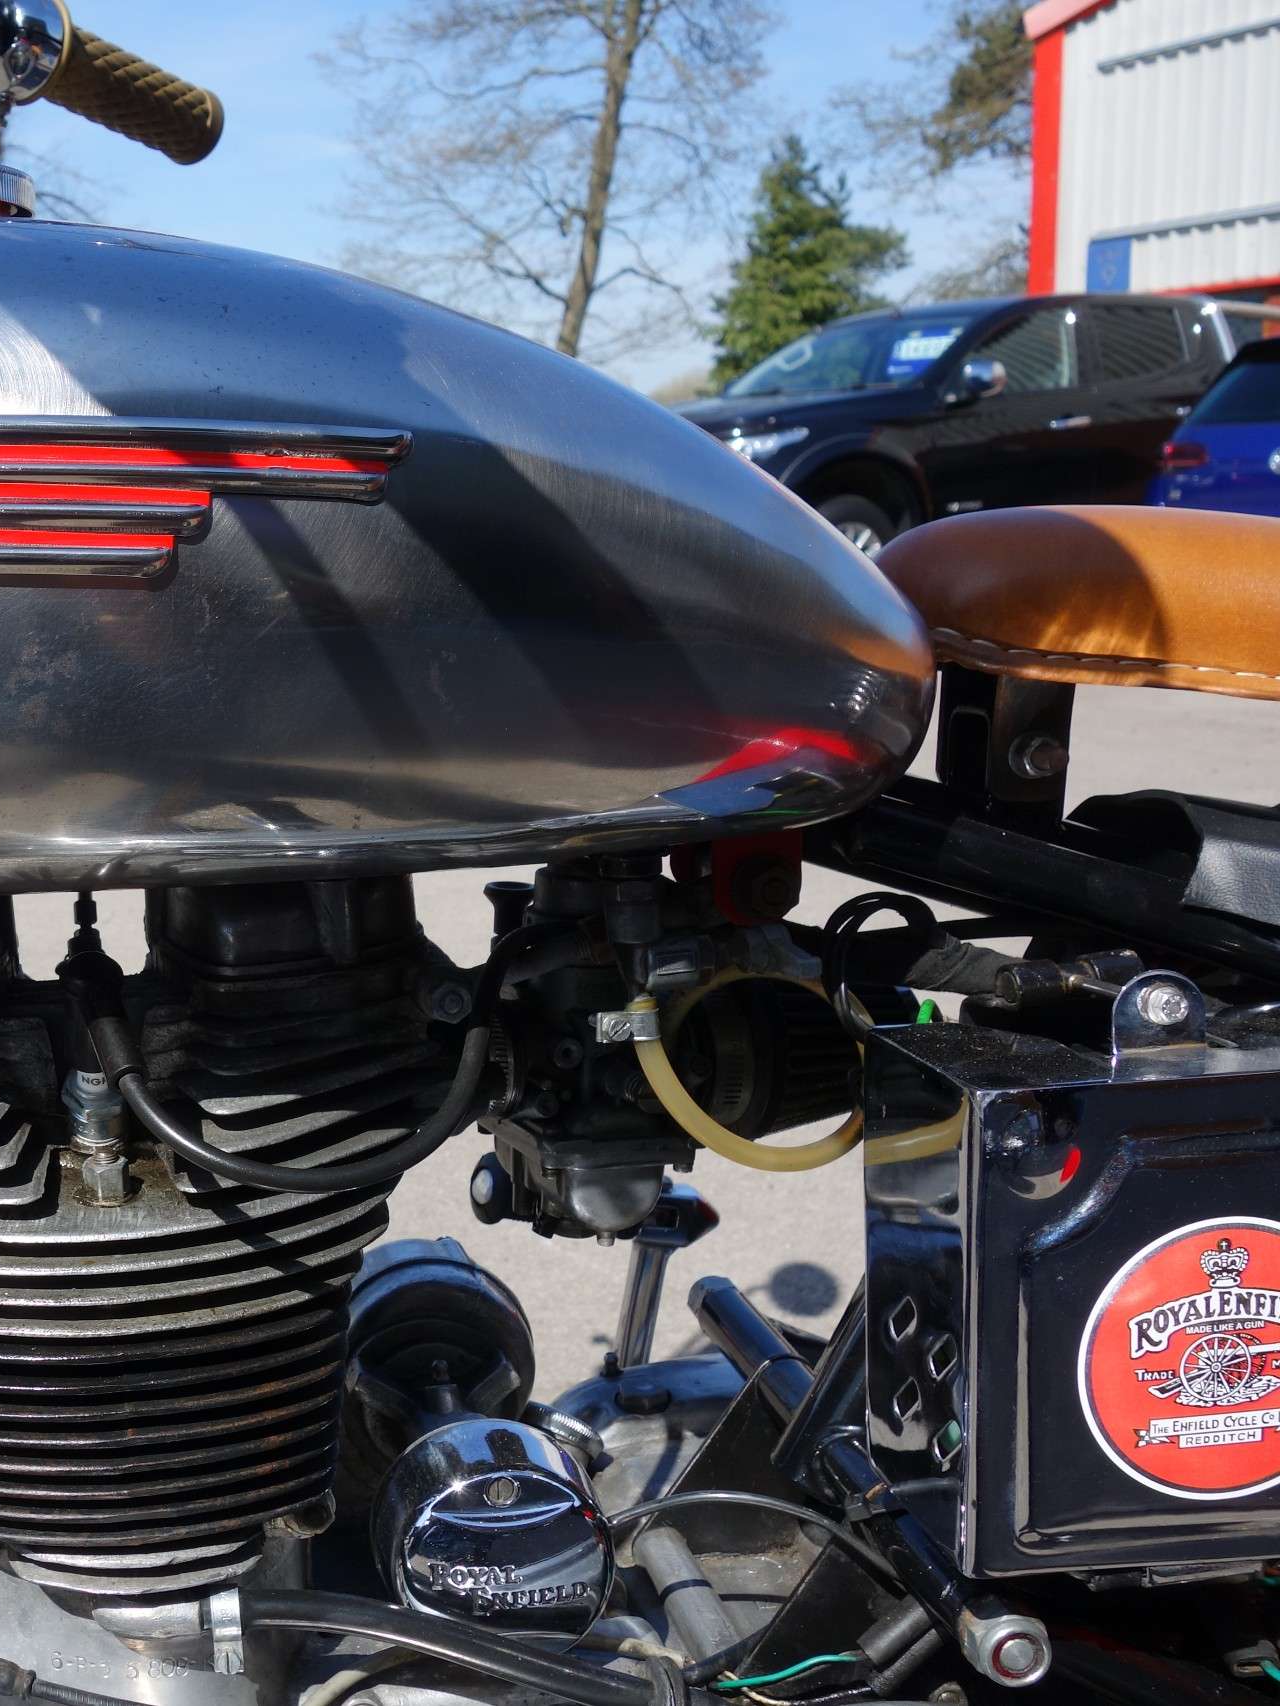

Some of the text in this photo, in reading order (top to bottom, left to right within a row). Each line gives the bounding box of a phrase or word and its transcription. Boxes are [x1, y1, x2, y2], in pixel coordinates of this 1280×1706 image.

[1185, 1320, 1265, 1335] MADE LIKE A GUN
[1134, 1369, 1175, 1381] TRADE
[1173, 1419, 1220, 1433] ENFIELD
[1224, 1415, 1257, 1428] CYCLE
[1185, 1431, 1256, 1446] REDDITCH
[428, 1563, 523, 1595] ROYAL
[470, 1582, 591, 1616] ENFIELD
